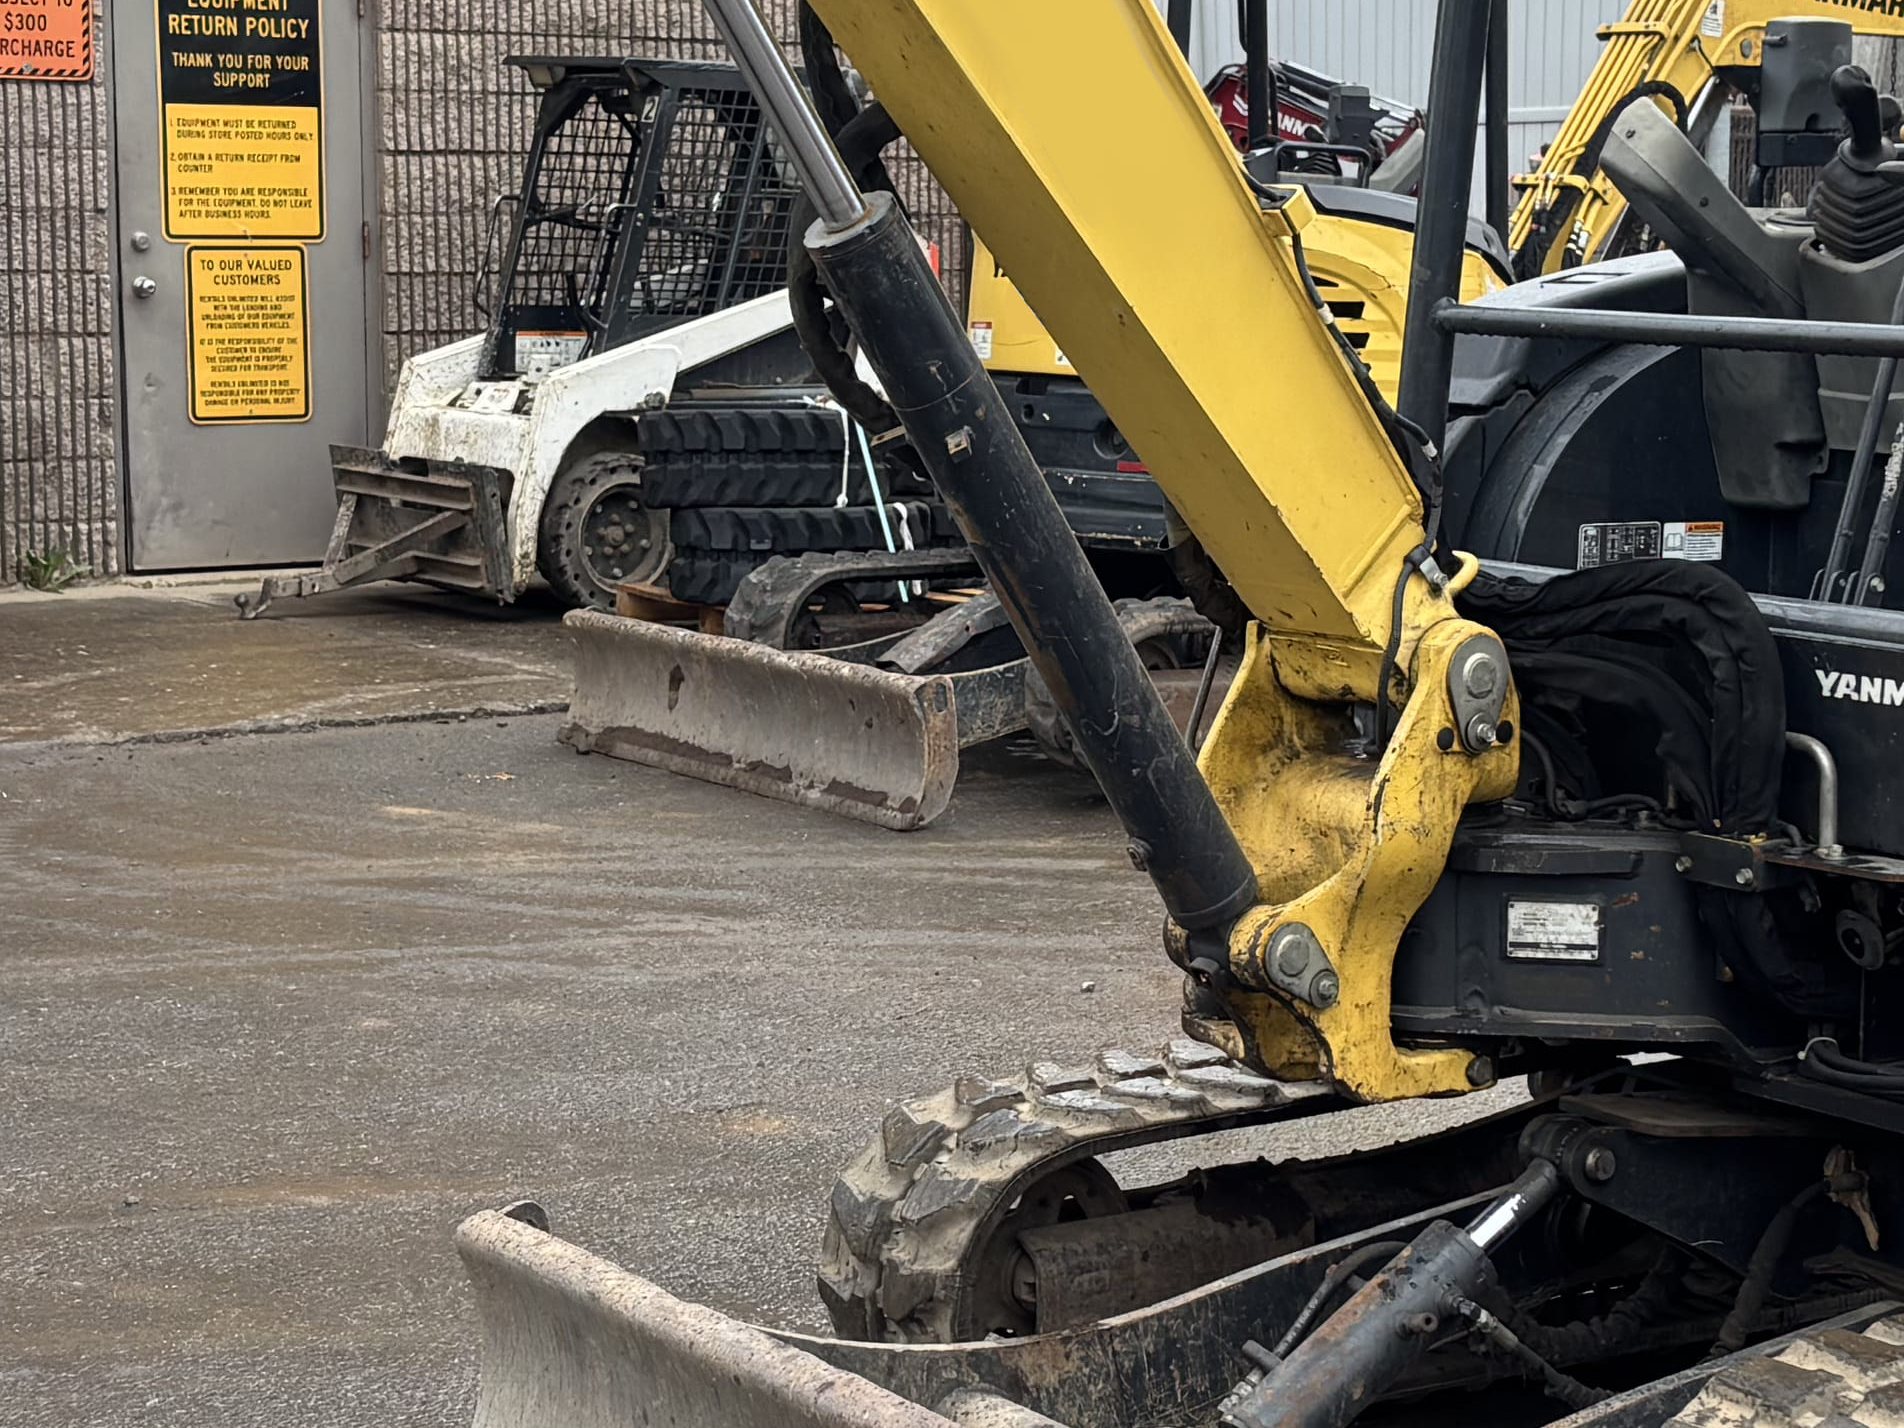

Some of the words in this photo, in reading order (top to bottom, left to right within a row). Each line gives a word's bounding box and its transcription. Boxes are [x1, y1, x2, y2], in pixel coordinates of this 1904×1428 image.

[4, 11, 47, 32] $300
[168, 14, 237, 36] RETURN
[246, 17, 309, 39] POLICY
[172, 52, 212, 68] THANK
[218, 54, 242, 68] YOU
[248, 55, 271, 69] FOR
[276, 56, 309, 70] YOUR
[213, 72, 270, 88] SUPPORT
[643, 97, 656, 121] 2
[177, 118, 220, 127] EQUIPMENT
[223, 120, 243, 128] MUST
[246, 120, 255, 128] BE
[258, 120, 296, 129] RETURNED
[177, 130, 205, 139] DURING
[209, 131, 232, 139] STORE
[235, 131, 263, 140] POSTED
[267, 132, 291, 140] HOURS
[294, 132, 313, 141] ONLY
[178, 153, 204, 161] OBTAIN
[215, 153, 244, 162] RETURN
[248, 154, 278, 162] RECEIPT
[281, 154, 300, 162] FROM
[178, 164, 213, 172] COUNTER
[179, 187, 220, 196] REMEMBER
[223, 188, 238, 196] YOU
[241, 188, 255, 196] ARE
[258, 188, 307, 197] RESPONSIBLE
[197, 199, 210, 207] THE
[260, 199, 270, 207] DO
[274, 200, 287, 208] NOT
[290, 200, 312, 208] LEAVE
[179, 210, 202, 218] AFTER
[205, 210, 241, 219] BUSINESS
[200, 260, 214, 271] TO
[220, 260, 242, 270] OUR
[247, 260, 292, 270] VALUED
[214, 274, 281, 285] CUSTOMERS
